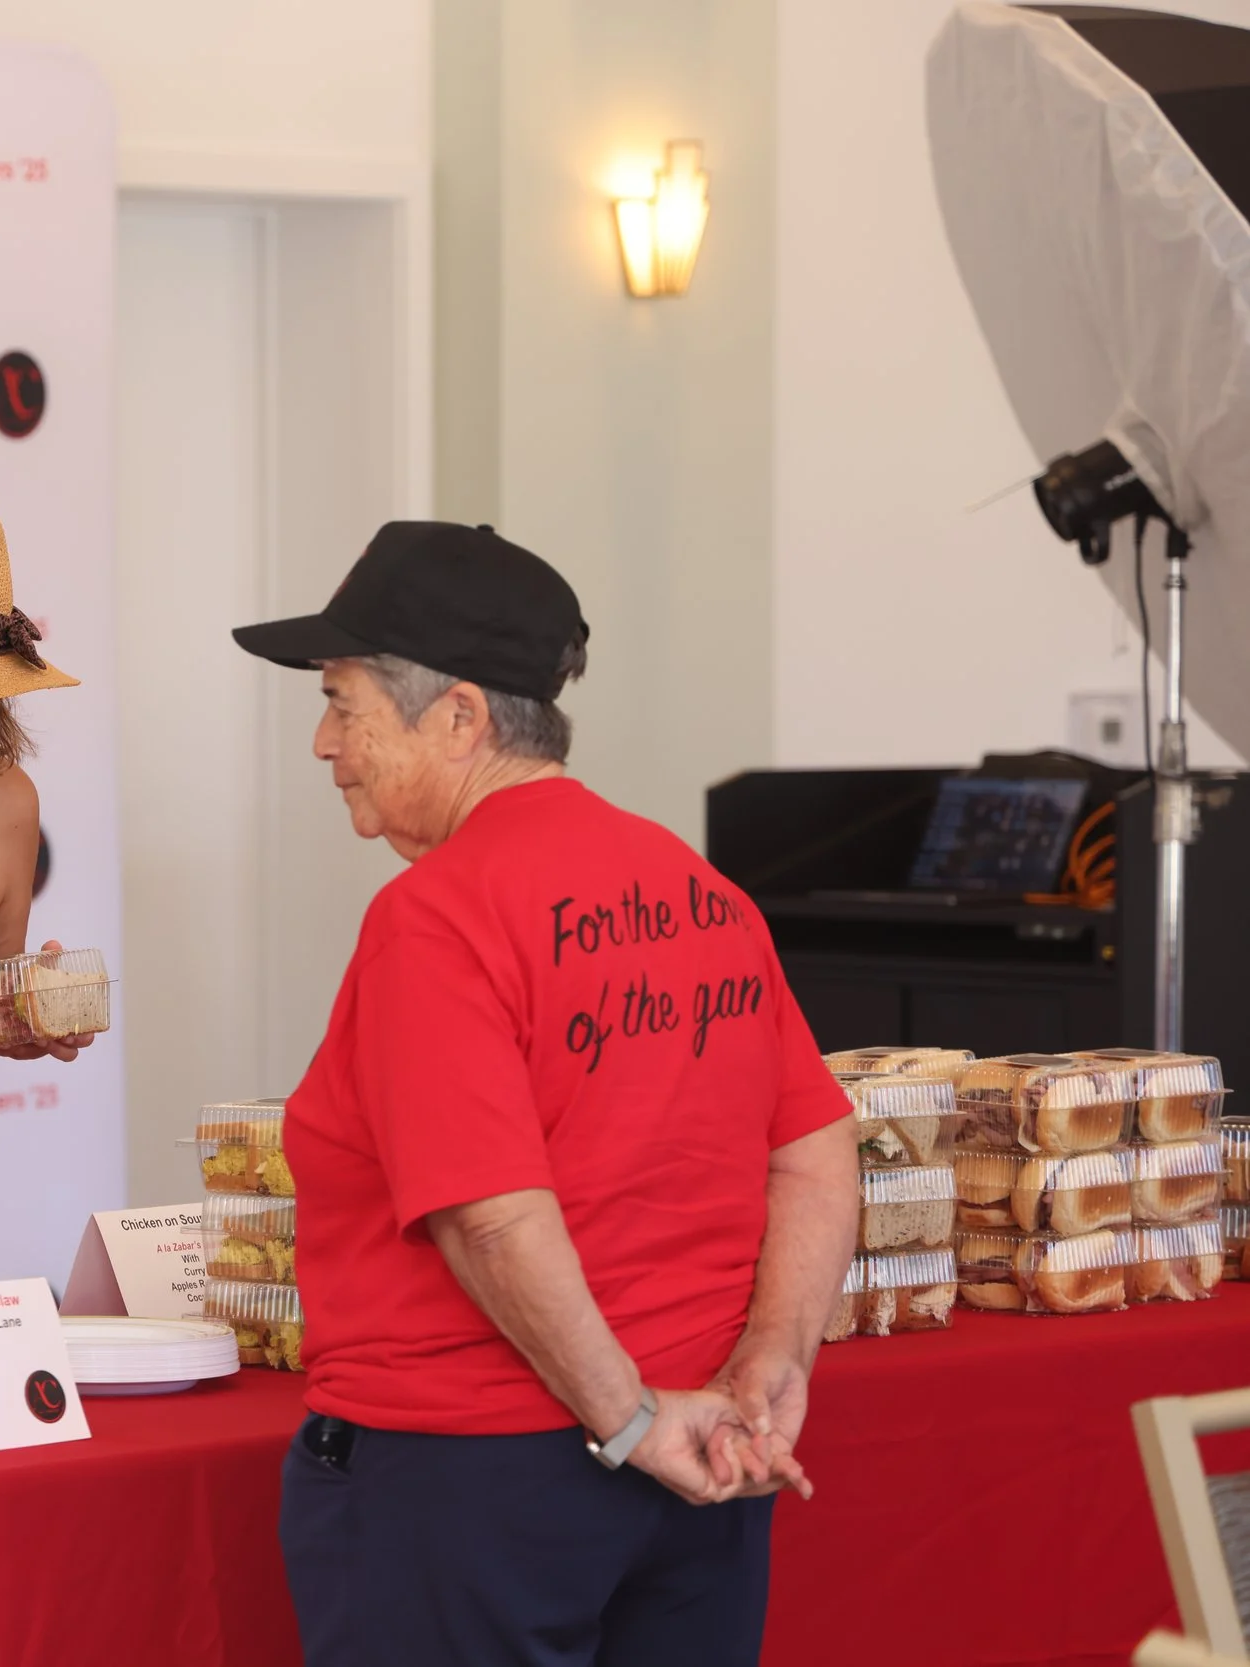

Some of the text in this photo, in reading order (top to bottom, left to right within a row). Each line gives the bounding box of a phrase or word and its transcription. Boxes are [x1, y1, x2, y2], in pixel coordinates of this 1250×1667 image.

[19, 157, 49, 184] '25
[550, 897, 623, 967] For
[621, 879, 679, 944] the
[566, 979, 613, 1074] of
[622, 970, 680, 1038] the
[29, 1083, 59, 1110] '25
[120, 1217, 163, 1231] Chicken
[164, 1217, 178, 1227] on
[156, 1241, 202, 1253] A la Zabar's
[181, 1254, 200, 1264] With
[184, 1267, 206, 1277] Curry
[171, 1280, 198, 1292] Apples
